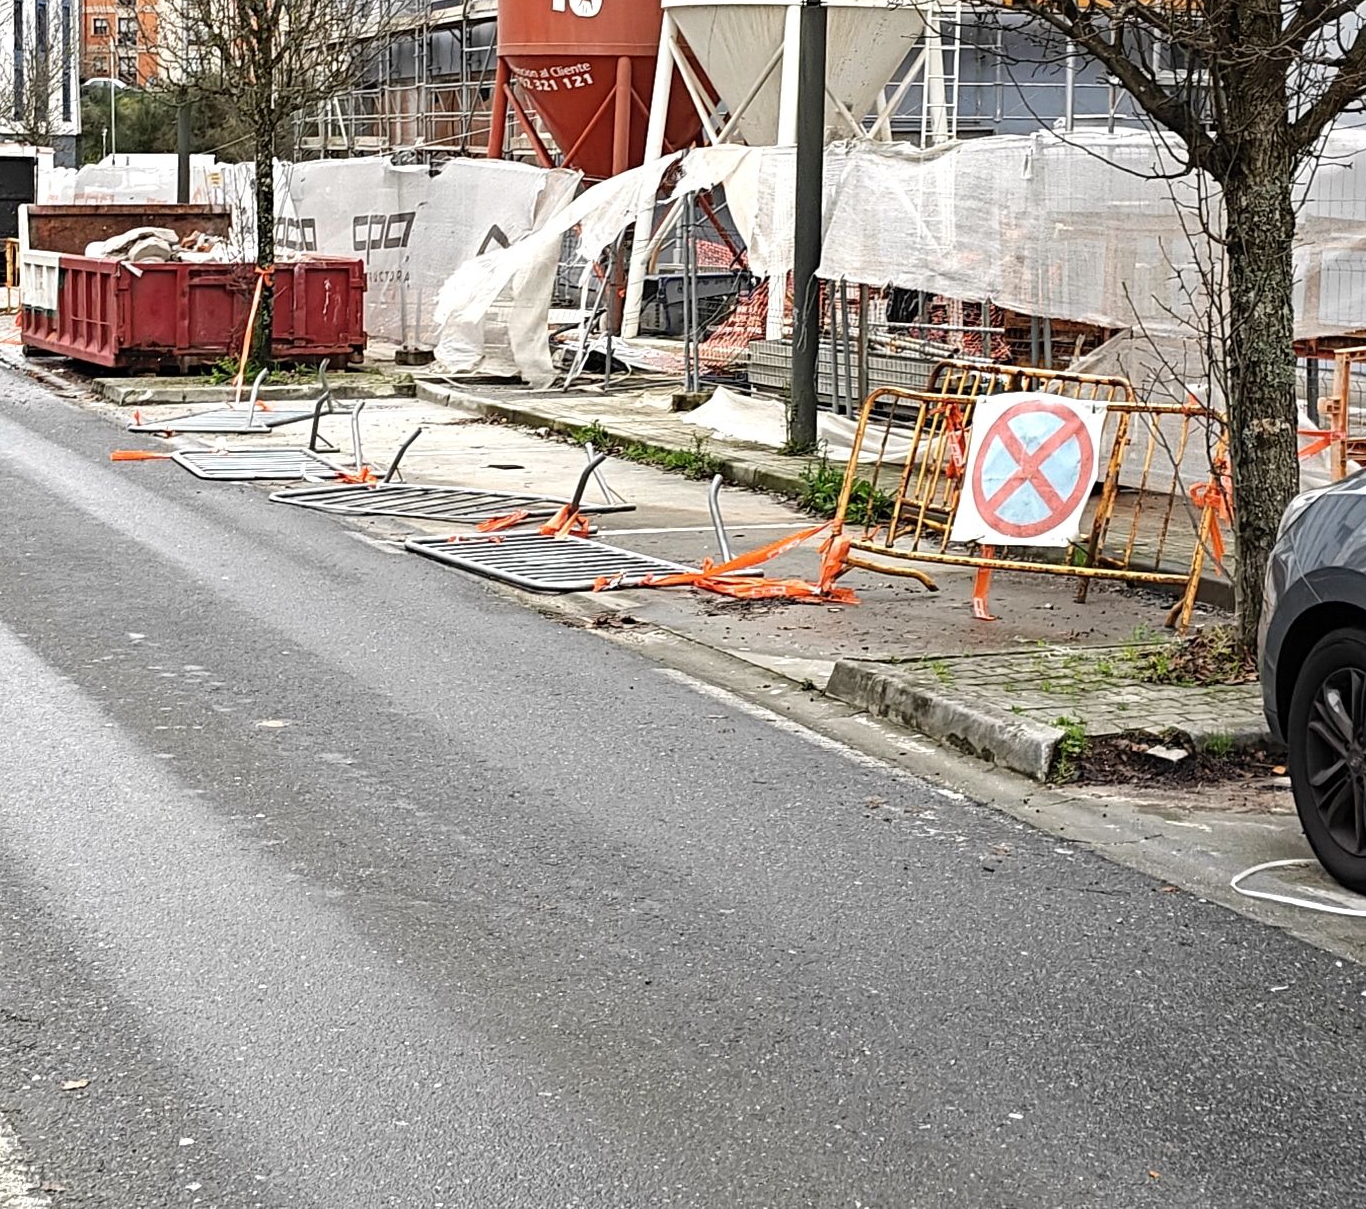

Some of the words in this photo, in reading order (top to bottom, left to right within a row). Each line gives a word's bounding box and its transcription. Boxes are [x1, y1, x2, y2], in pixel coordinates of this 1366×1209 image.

[550, 62, 591, 77] Cliente
[533, 79, 558, 91] 321
[563, 73, 593, 89] 121
